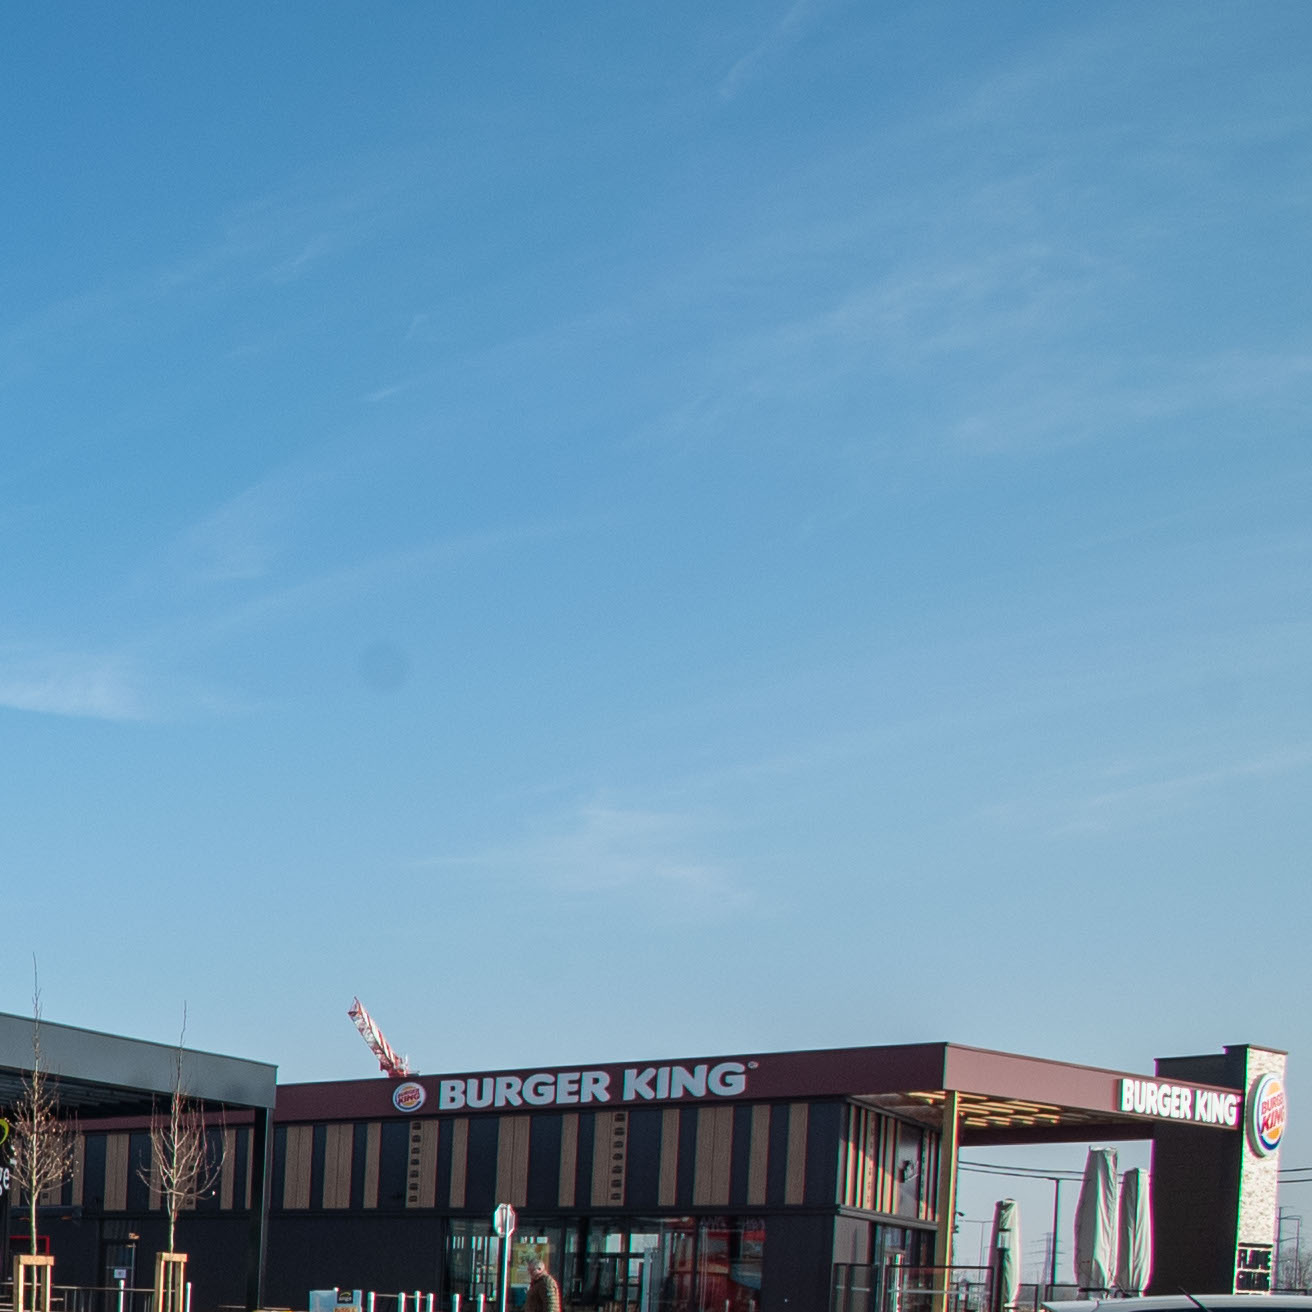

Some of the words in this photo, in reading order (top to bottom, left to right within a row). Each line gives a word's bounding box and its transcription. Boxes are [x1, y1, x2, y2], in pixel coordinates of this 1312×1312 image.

[438, 1070, 611, 1110] BURGER
[622, 1061, 746, 1101] KING
[1121, 1078, 1192, 1120] BURGER
[1195, 1089, 1238, 1126] KING
[1262, 1094, 1285, 1110] BURGER
[1261, 1107, 1285, 1133] KING
